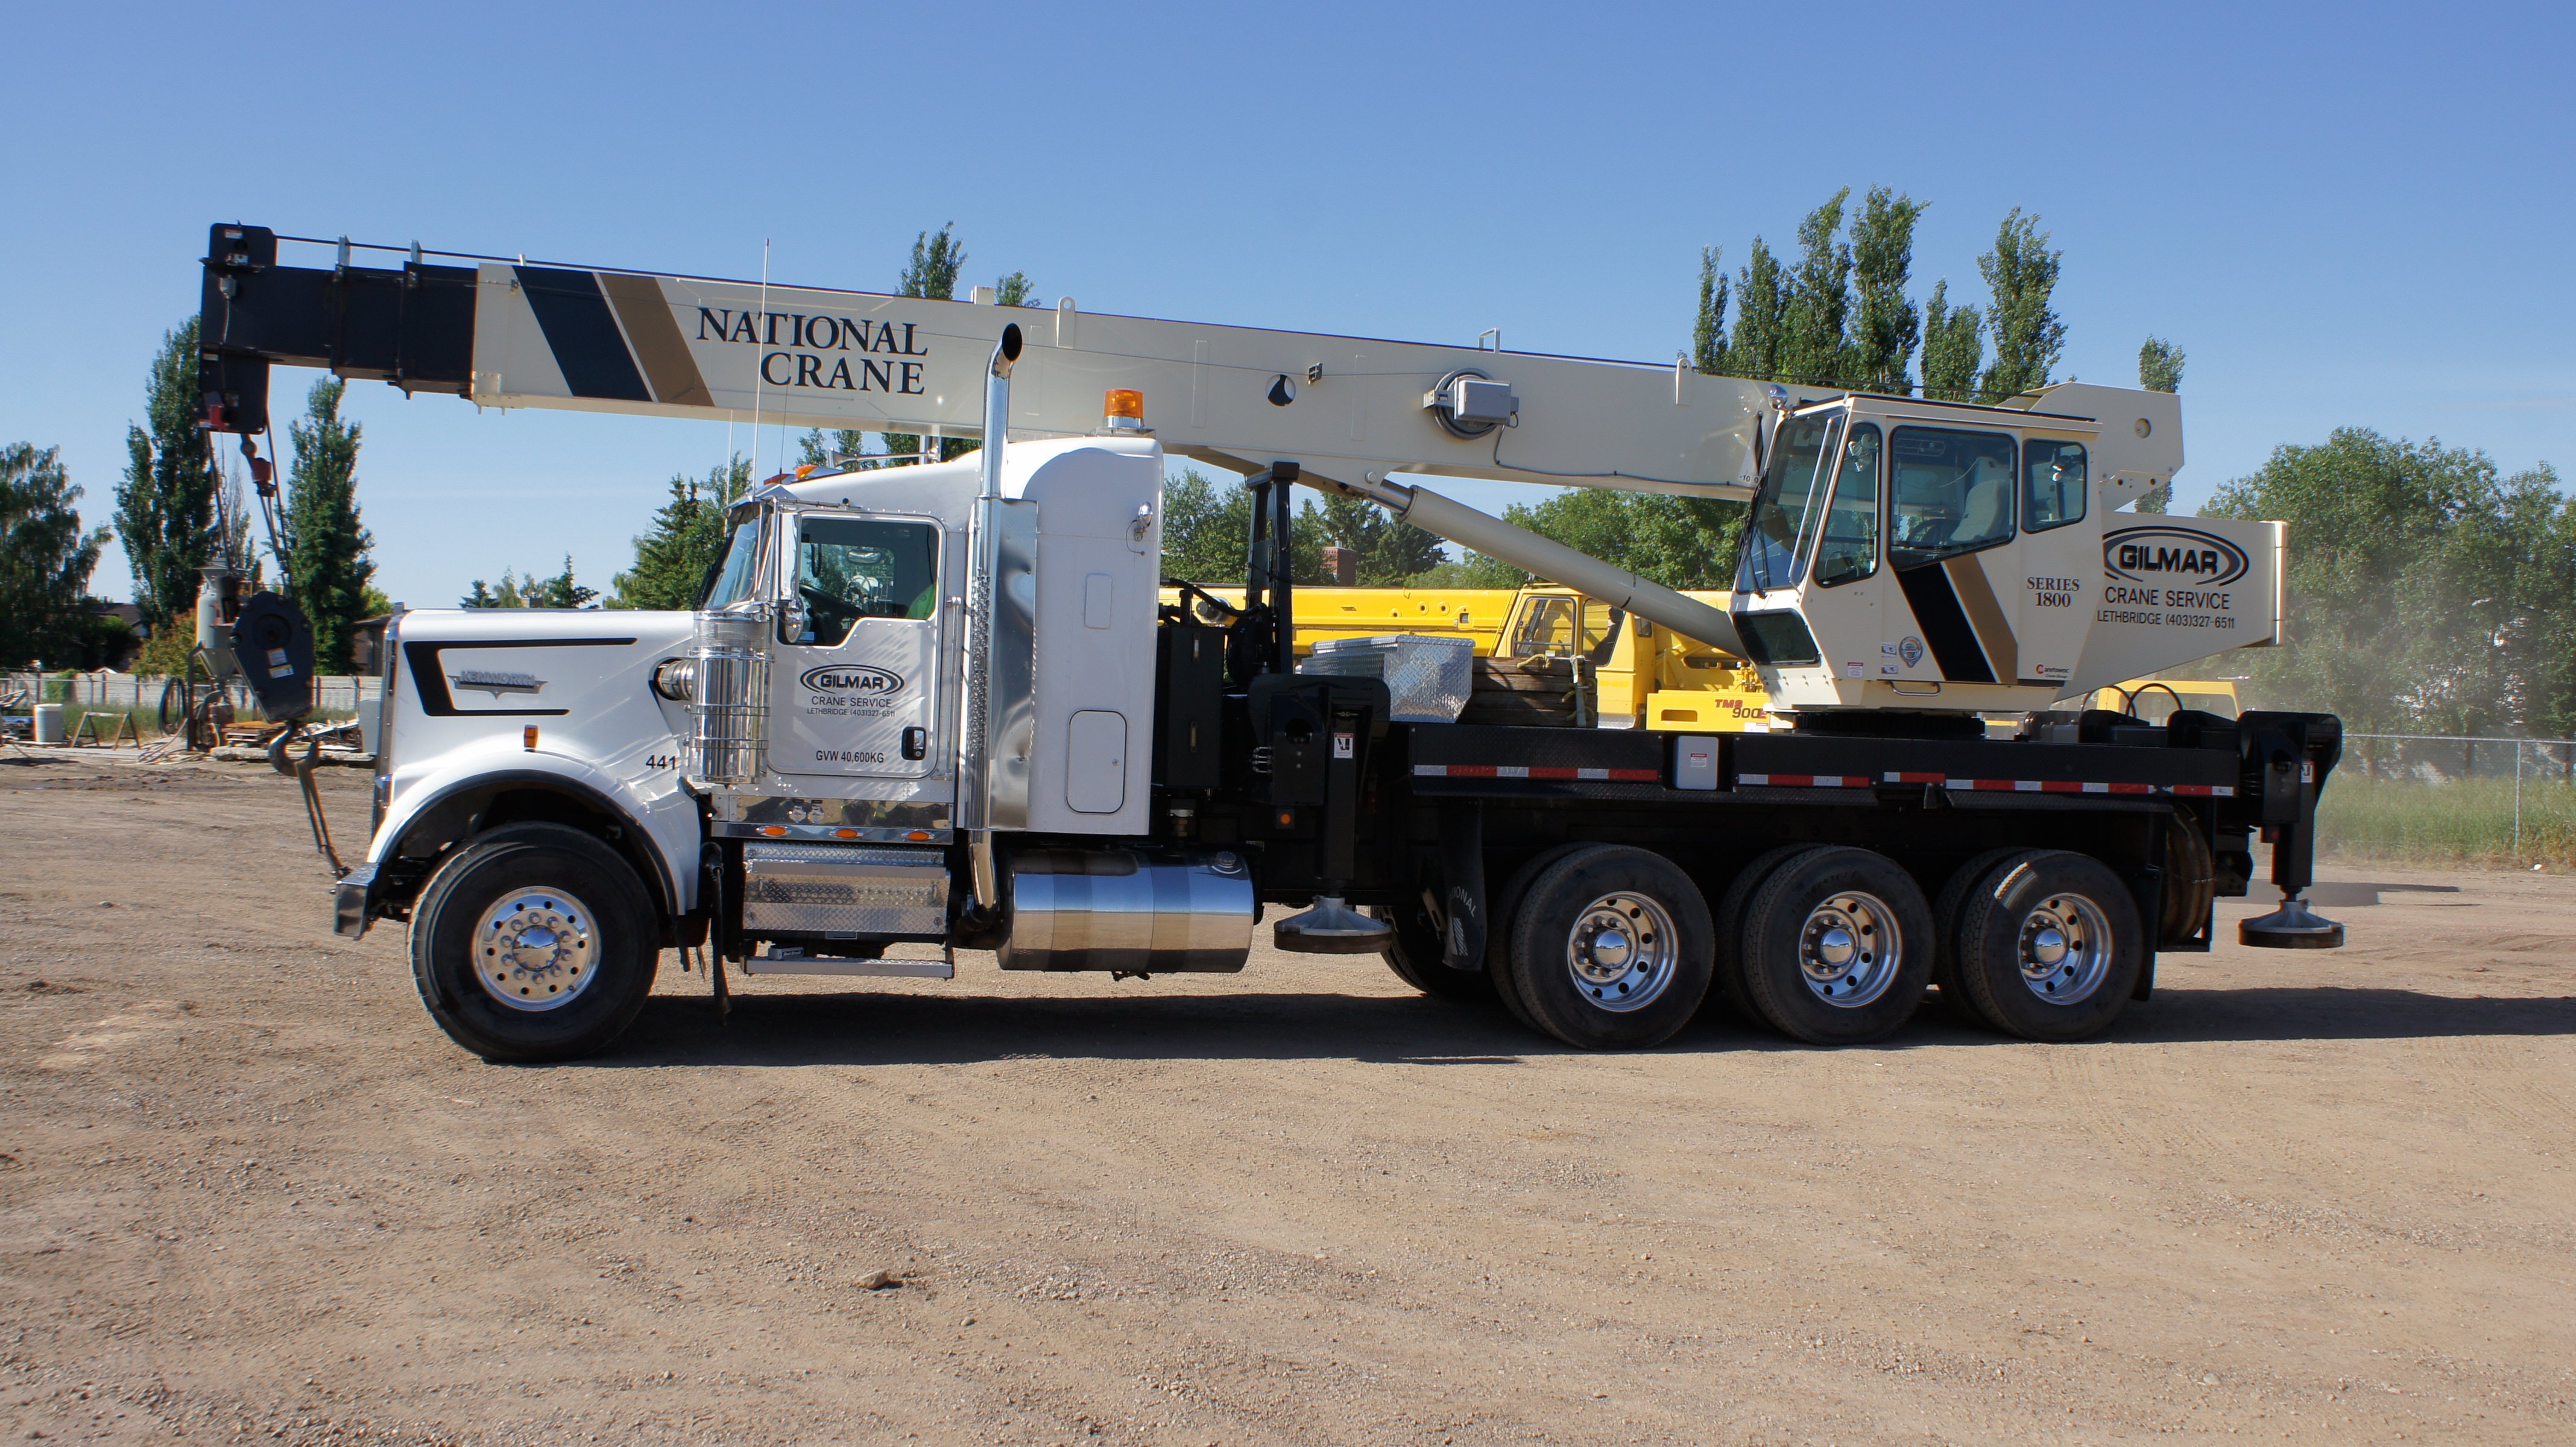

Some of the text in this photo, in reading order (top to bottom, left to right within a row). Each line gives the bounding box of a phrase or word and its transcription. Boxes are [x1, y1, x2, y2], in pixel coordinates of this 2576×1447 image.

[697, 307, 928, 356] NATIONAL
[761, 352, 926, 395] CRANE
[2119, 544, 2218, 575] GILMAR
[2027, 577, 2080, 592] SERIES
[2035, 591, 2071, 608] 1800
[2105, 587, 2230, 610] CRANE SERVICE
[2097, 610, 2235, 629] LETHBRIDGE (403)327-6511
[461, 670, 535, 686] KENWORTH
[821, 675, 884, 690] GILMAR
[811, 696, 892, 708] CRANE SERVICE
[1715, 699, 1743, 708] TMS
[850, 708, 895, 717] (403)327-6511
[646, 755, 676, 770] 441
[815, 750, 884, 763] GVW 40,600KG
